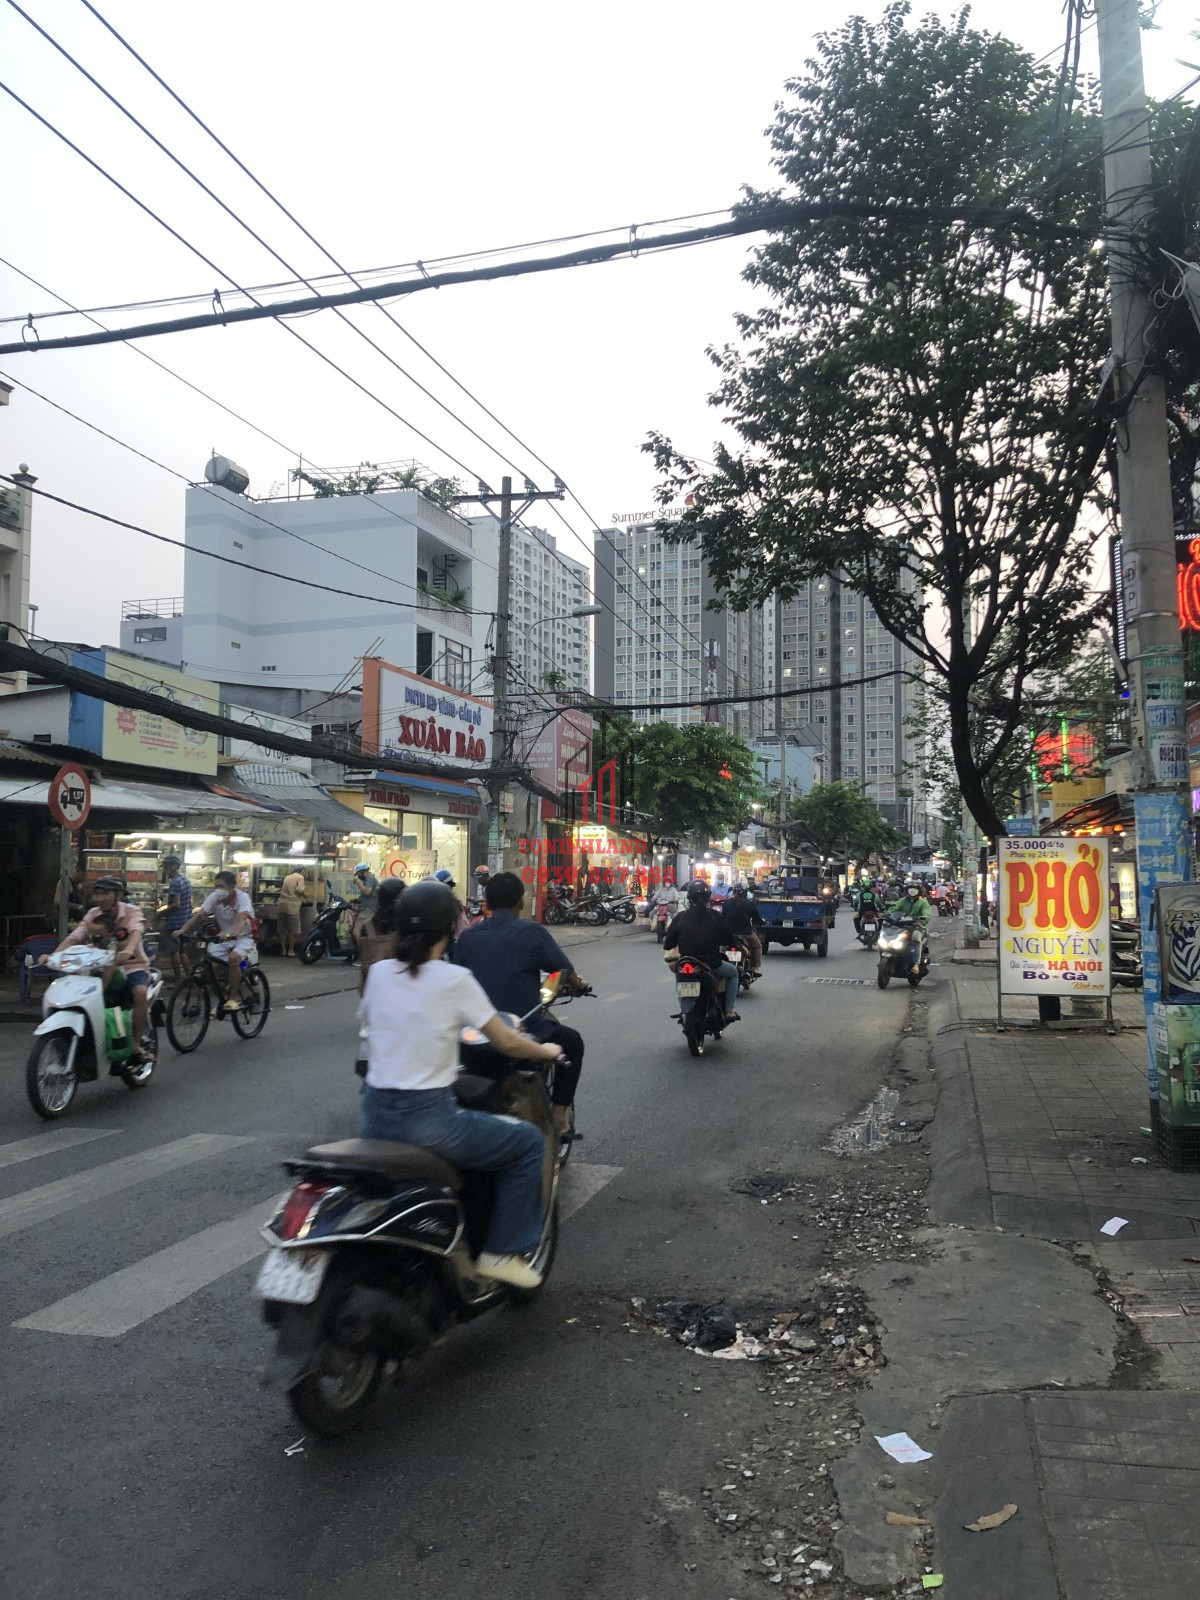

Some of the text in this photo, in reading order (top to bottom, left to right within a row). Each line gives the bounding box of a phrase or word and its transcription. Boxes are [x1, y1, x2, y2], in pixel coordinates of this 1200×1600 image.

[611, 511, 656, 523] Summer
[398, 715, 451, 755] XUÂN
[455, 724, 486, 763] BẢO
[1038, 851, 1059, 859] 24/24
[1005, 843, 1100, 930] PHỞ
[1012, 932, 1100, 956] NGUYỄN
[1048, 958, 1070, 971] HÀ
[1074, 958, 1103, 974] NỘI
[1023, 970, 1089, 981] Bò Gà
